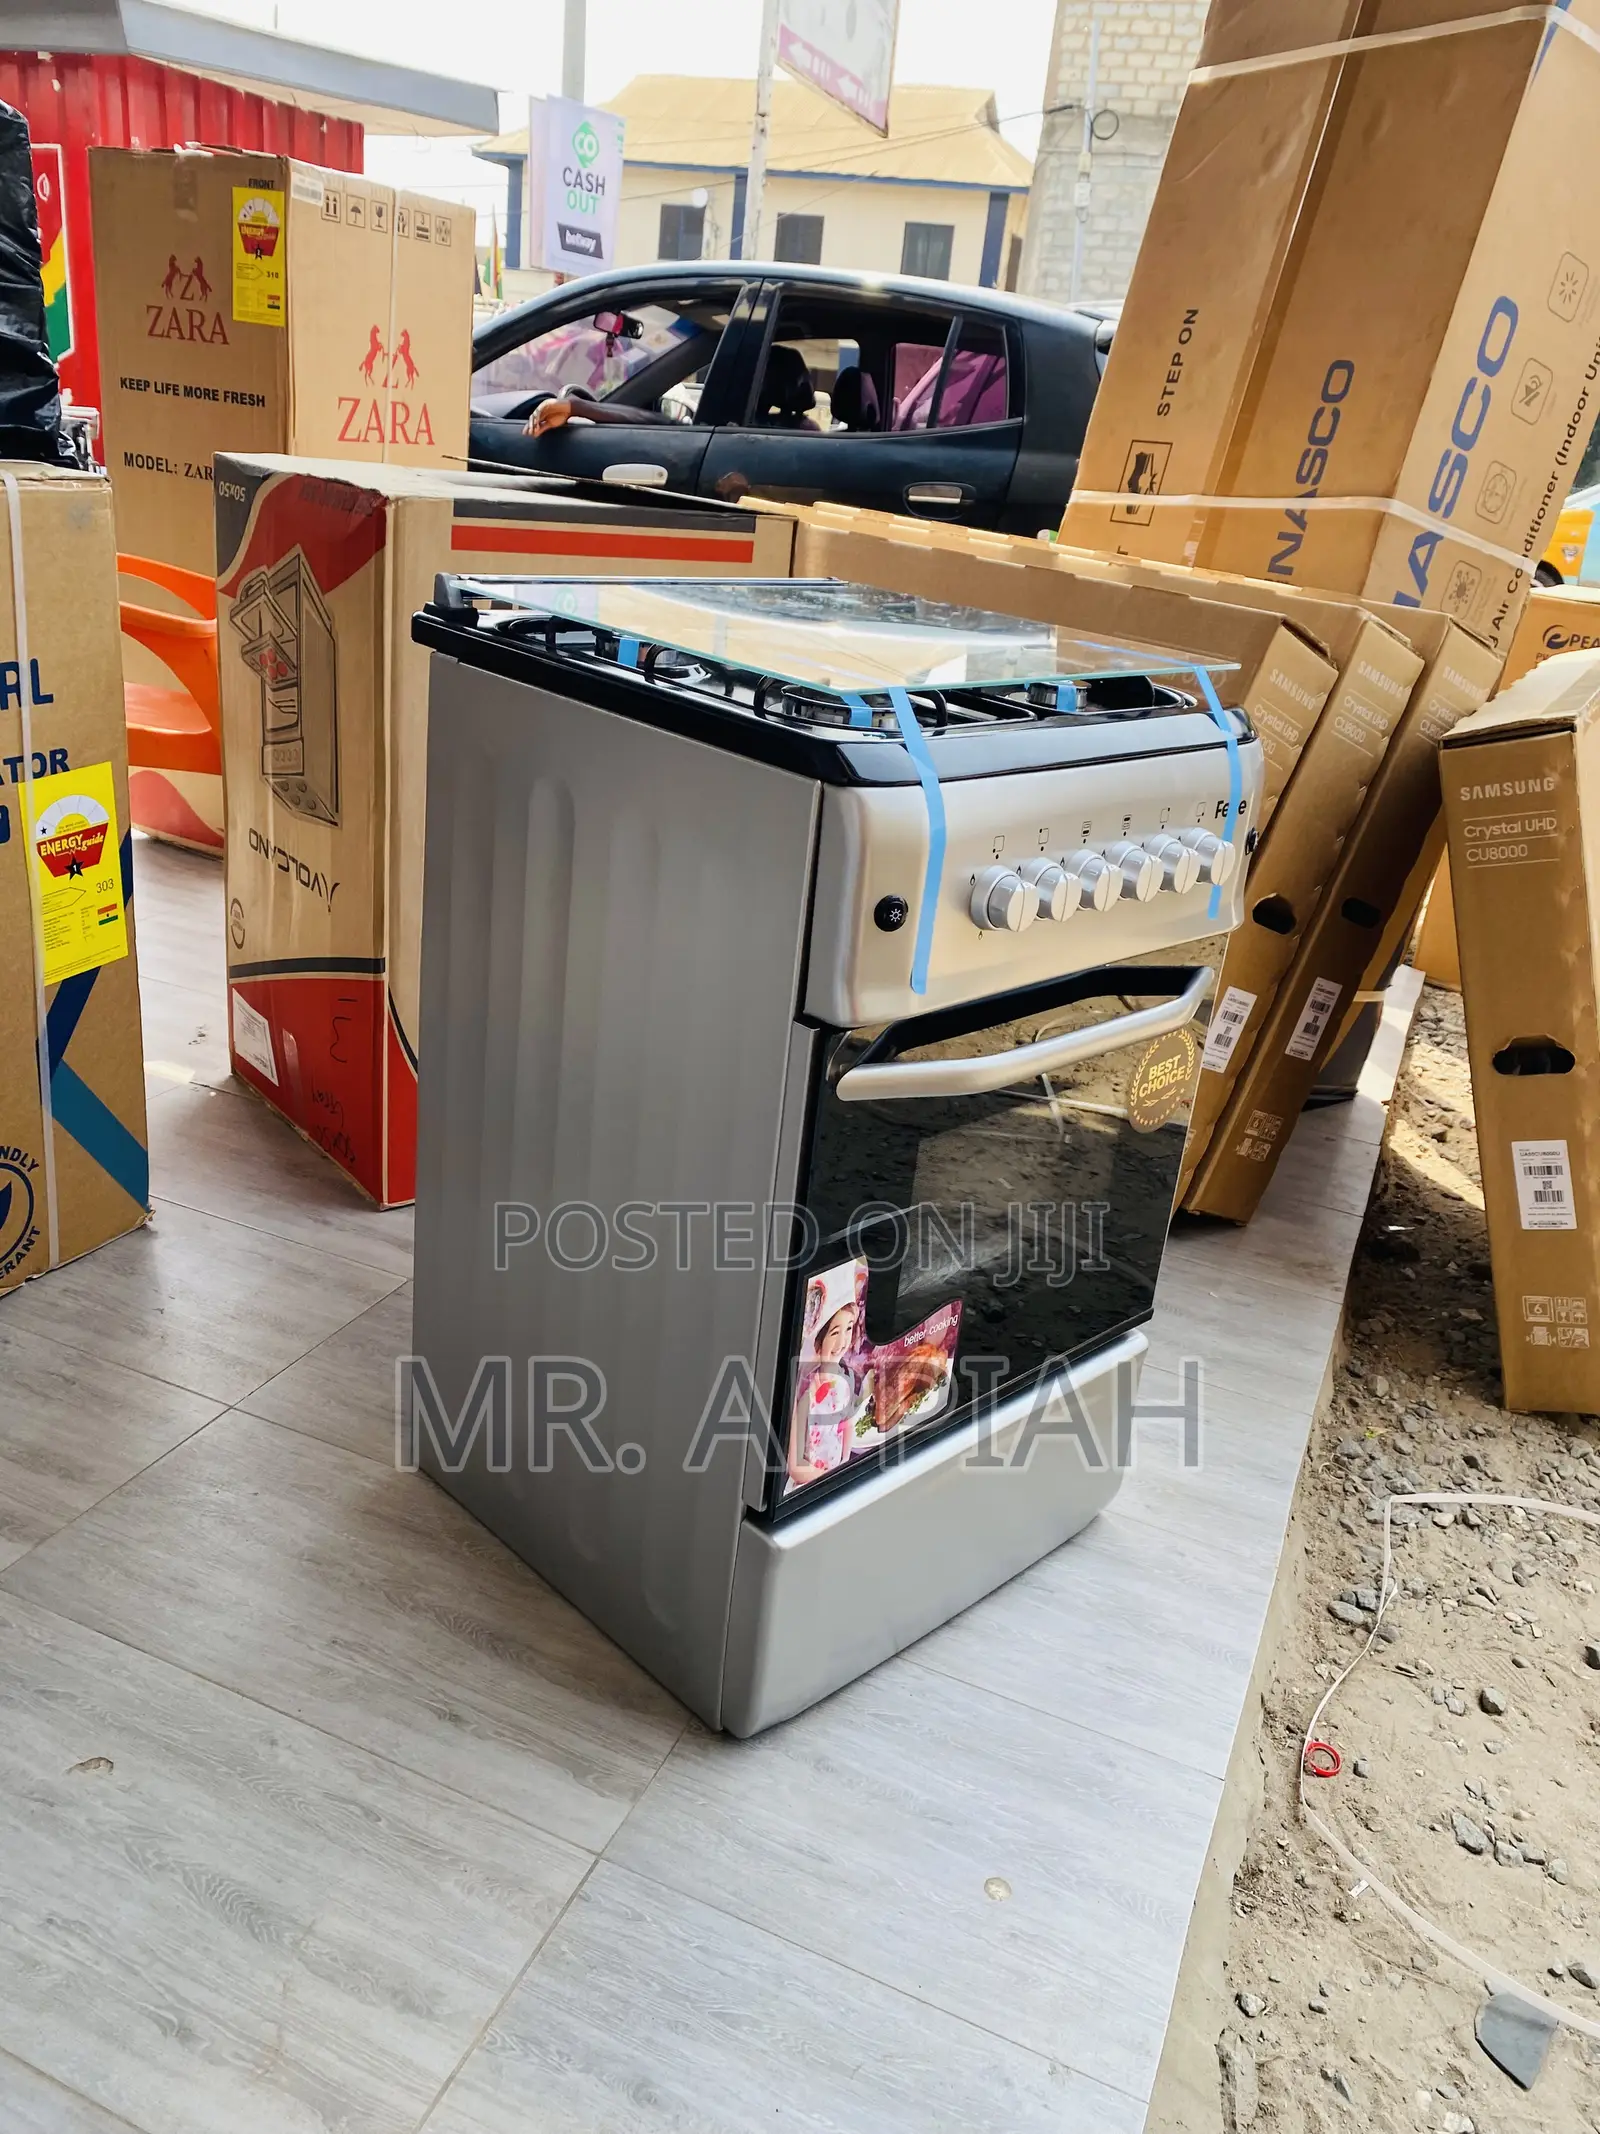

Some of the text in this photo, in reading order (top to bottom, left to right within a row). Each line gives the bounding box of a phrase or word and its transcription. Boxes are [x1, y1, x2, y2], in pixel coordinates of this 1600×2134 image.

[248, 178, 275, 189] FRONT
[562, 166, 606, 196] CASH
[566, 190, 600, 215] OUT
[145, 303, 230, 345] ZARA
[1156, 308, 1200, 417] STEP ON
[120, 376, 266, 407] KEEP LIFE MORE FRESH
[337, 396, 436, 445] ZARA
[123, 451, 214, 481] MODEL: ZAR
[1267, 359, 1355, 576] NASCO
[1491, 600, 1510, 631] Air
[1506, 471, 1560, 594] Coditioner
[1554, 386, 1590, 467] (Indoor
[1269, 668, 1317, 711] SAMSUNG
[1357, 660, 1404, 699] SAMSUNG
[1460, 776, 1555, 801] SAMSUNG
[1214, 799, 1247, 819] Fee
[1463, 816, 1557, 840] Crystal UHD
[40, 831, 104, 857] ENERGY guide
[1466, 843, 1528, 862] CU8000
[96, 878, 115, 894] 303
[1138, 1064, 1186, 1098] CHOICE
[1148, 1053, 1182, 1081] BEST
[904, 1314, 959, 1347] better cooking
